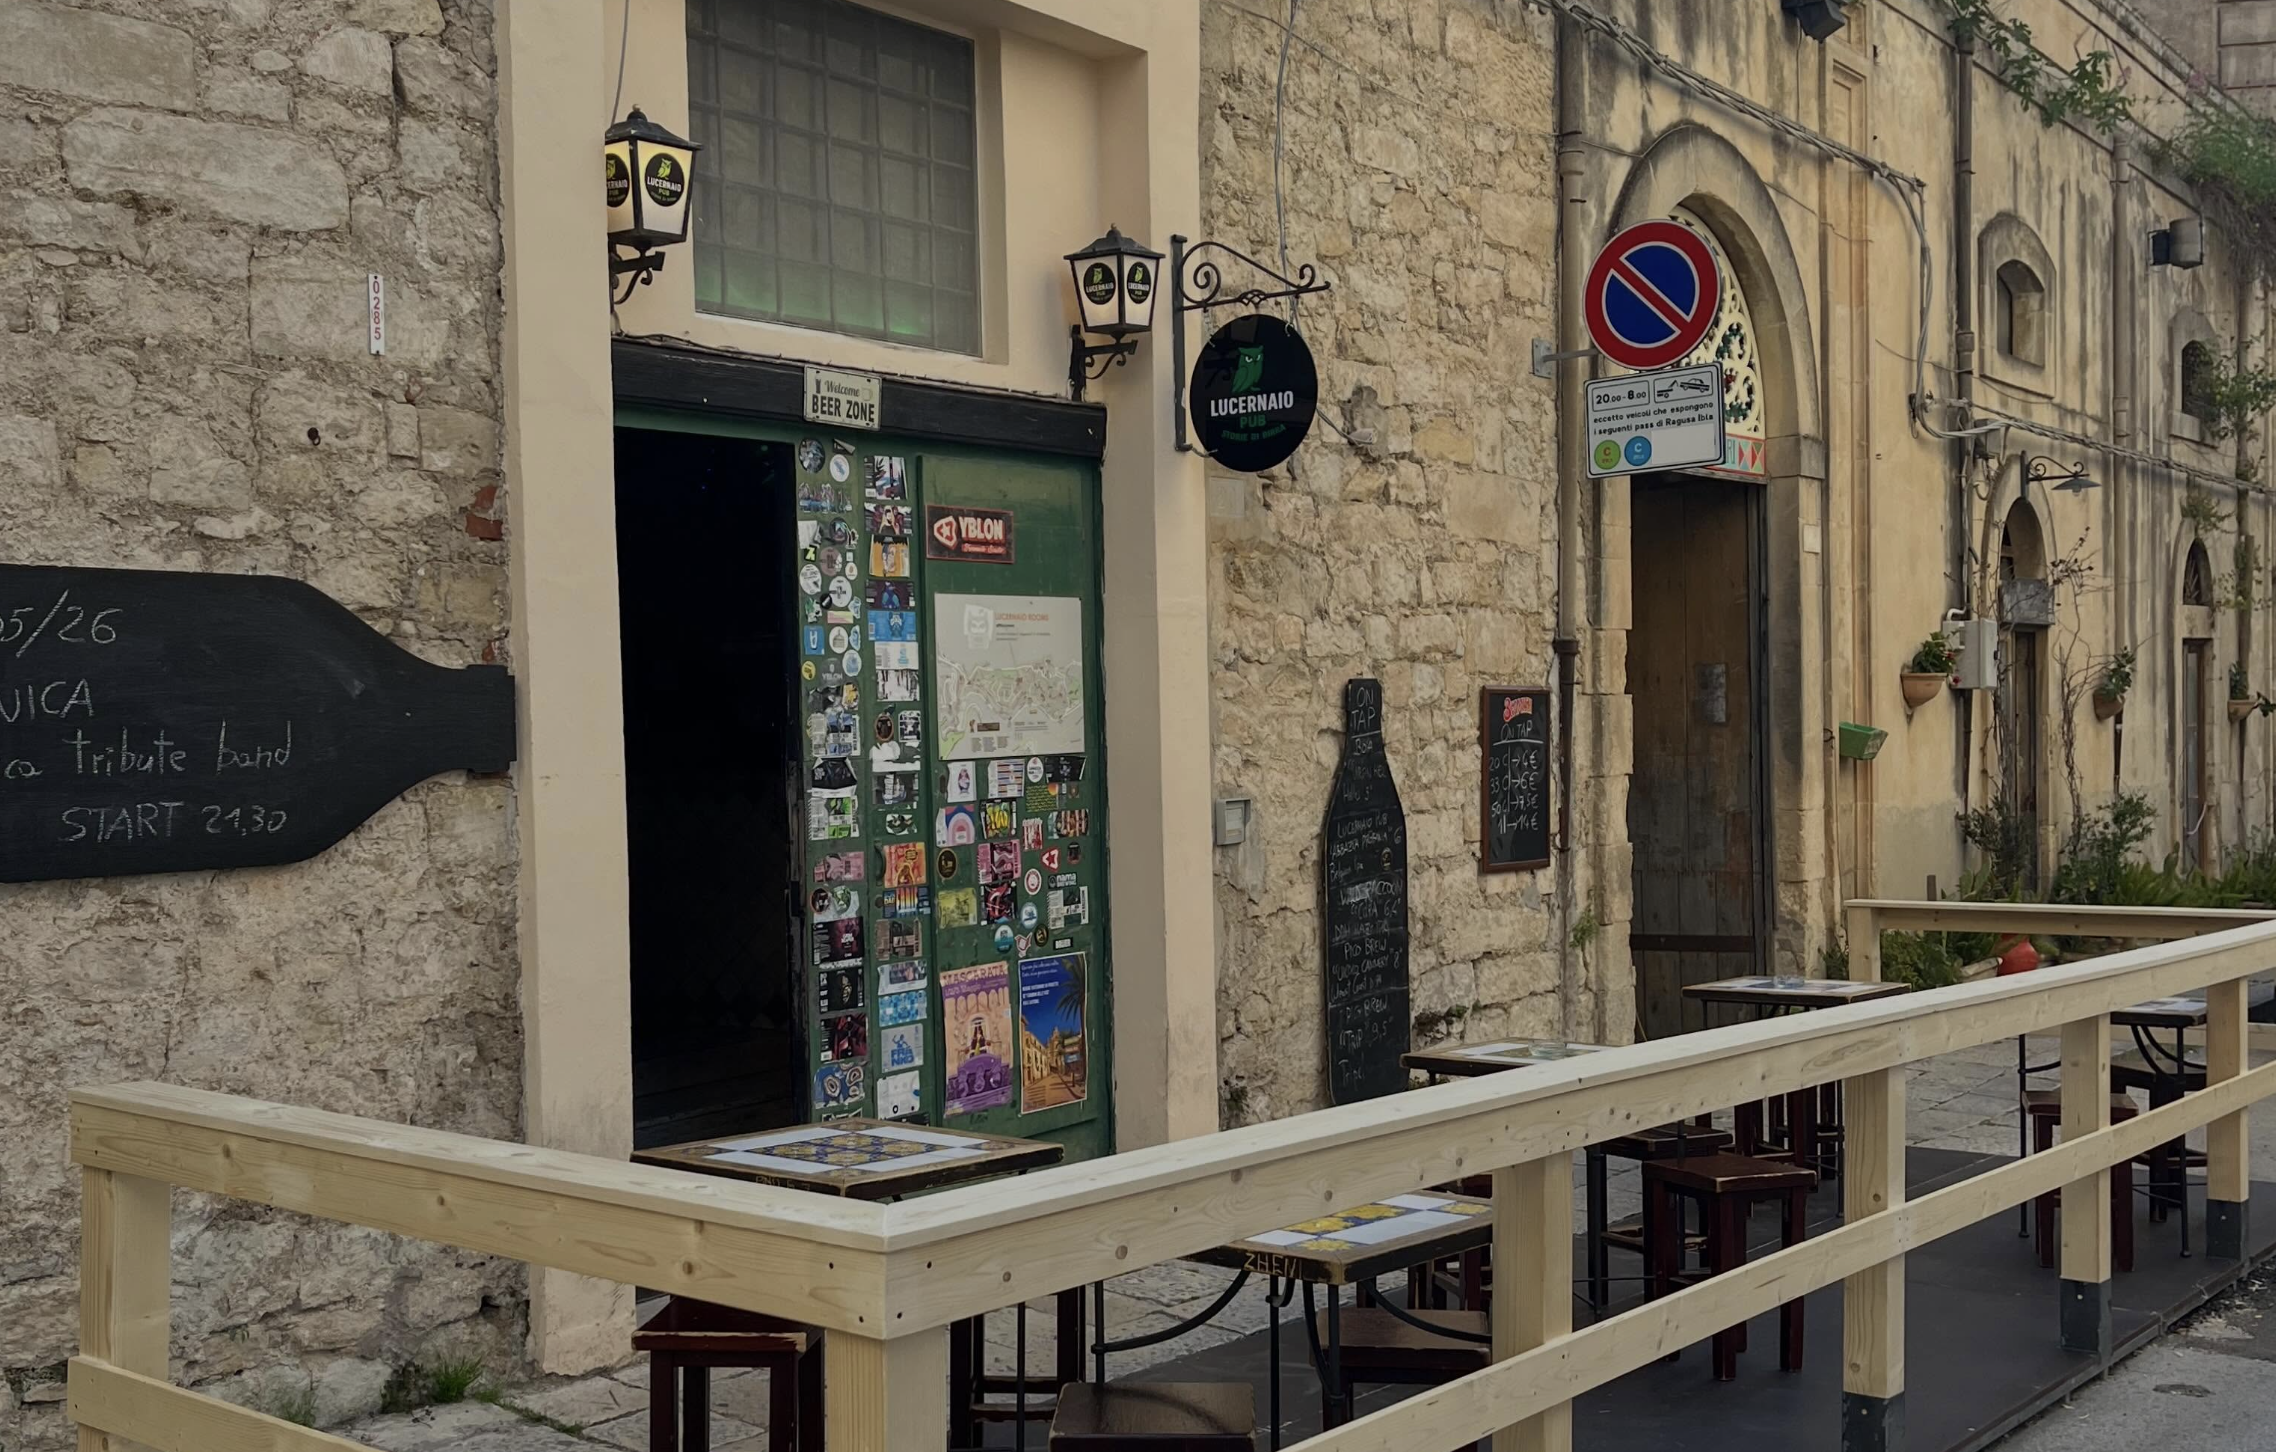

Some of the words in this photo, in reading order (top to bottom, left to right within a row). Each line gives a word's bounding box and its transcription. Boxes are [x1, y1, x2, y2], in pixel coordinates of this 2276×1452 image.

[646, 176, 682, 193] LUCERNAIO
[372, 280, 382, 340] 0285
[824, 380, 860, 397] Welcome
[812, 394, 842, 417] BEER
[846, 399, 875, 423] ZONE
[1210, 390, 1294, 417] LUCERNAIO
[1593, 413, 1624, 424] eccetto
[1626, 409, 1651, 420] veicoli
[1653, 406, 1667, 416] che
[1670, 401, 1714, 415] espongono
[1240, 414, 1267, 429] PUB
[1598, 423, 1633, 436] seguenti
[1635, 420, 1654, 432] pass
[1656, 417, 1664, 428] di
[1665, 415, 1696, 428] Ragusa
[1698, 412, 1714, 421] Ibla
[1221, 429, 1248, 442] STORIE
[1250, 432, 1260, 440] DI
[1603, 446, 1612, 456] C
[1634, 442, 1643, 453] C
[958, 516, 1005, 541] YBLON
[0, 588, 123, 659] 5/26
[1356, 686, 1374, 707] ON
[1351, 706, 1376, 731] TAP
[1500, 723, 1515, 742] ON
[1517, 719, 1533, 739] TAP
[62, 725, 188, 776] tribute
[216, 718, 292, 776] band
[1489, 757, 1500, 771] 20
[1490, 776, 1500, 795] 33
[1491, 800, 1501, 818] 50
[60, 800, 185, 843] START
[1364, 936, 1388, 956] BREW
[942, 964, 1005, 984] MASCARATA
